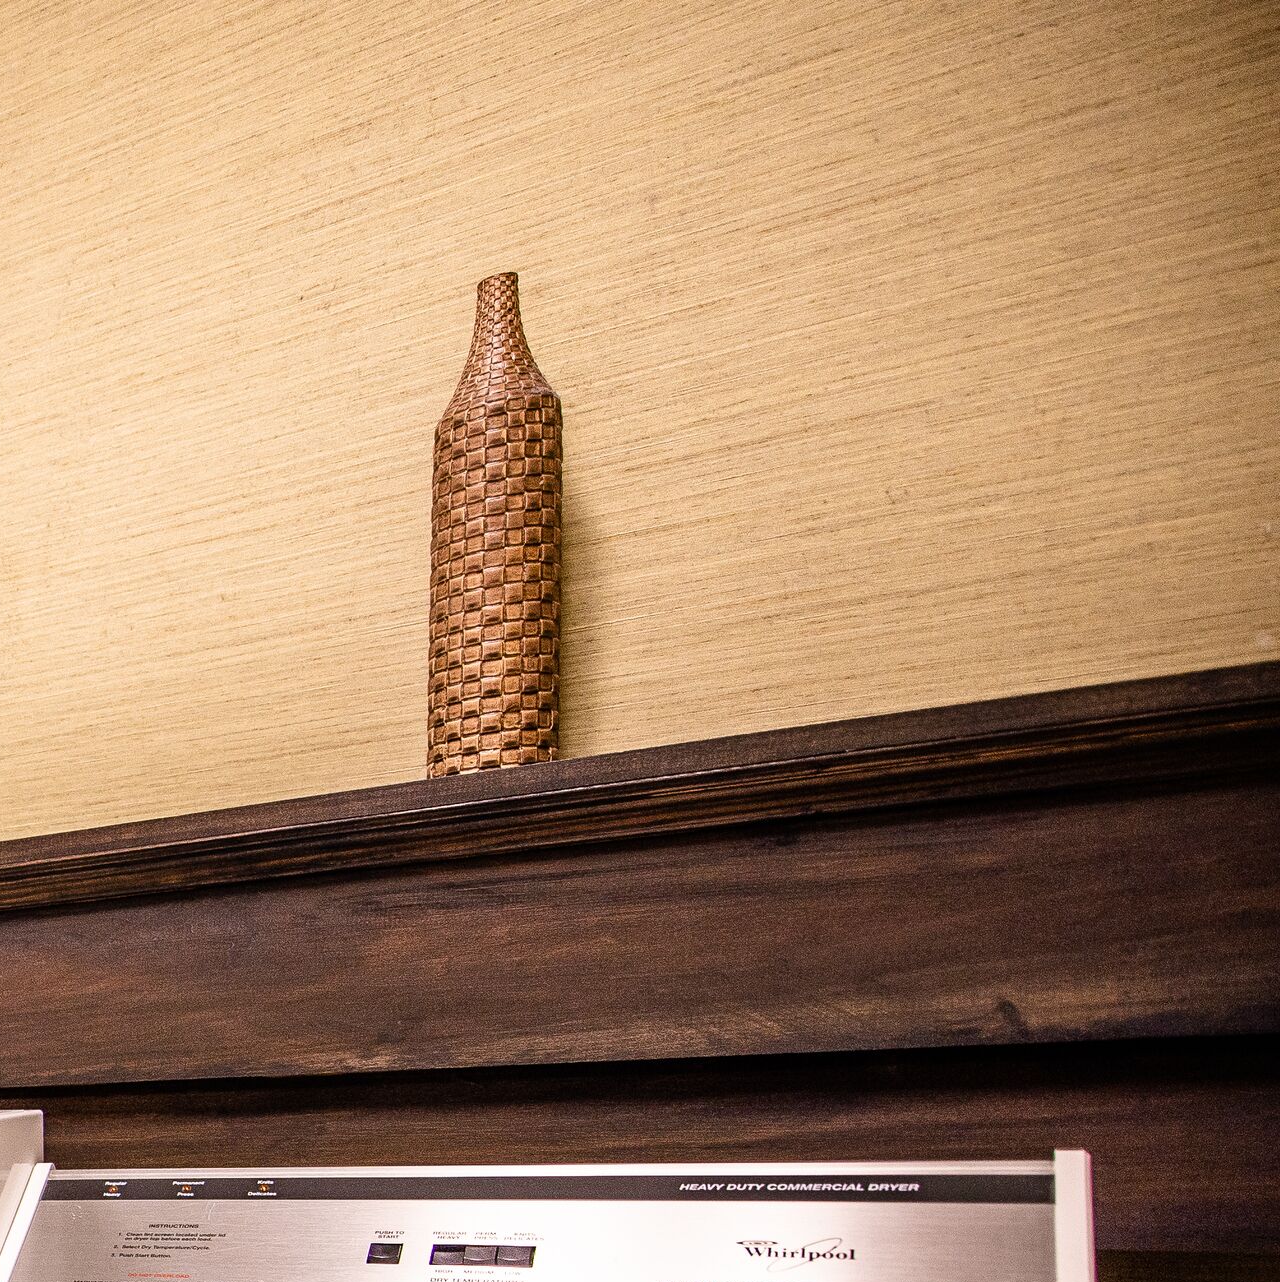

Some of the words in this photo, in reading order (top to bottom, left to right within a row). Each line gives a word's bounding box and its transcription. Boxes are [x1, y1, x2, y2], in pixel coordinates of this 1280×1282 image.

[679, 1183, 725, 1191] HEAVY
[726, 1183, 765, 1191] DUTY
[766, 1183, 865, 1191] COMMERCIAL
[867, 1183, 920, 1192] DRYER
[744, 1246, 856, 1262] Whirlpool
